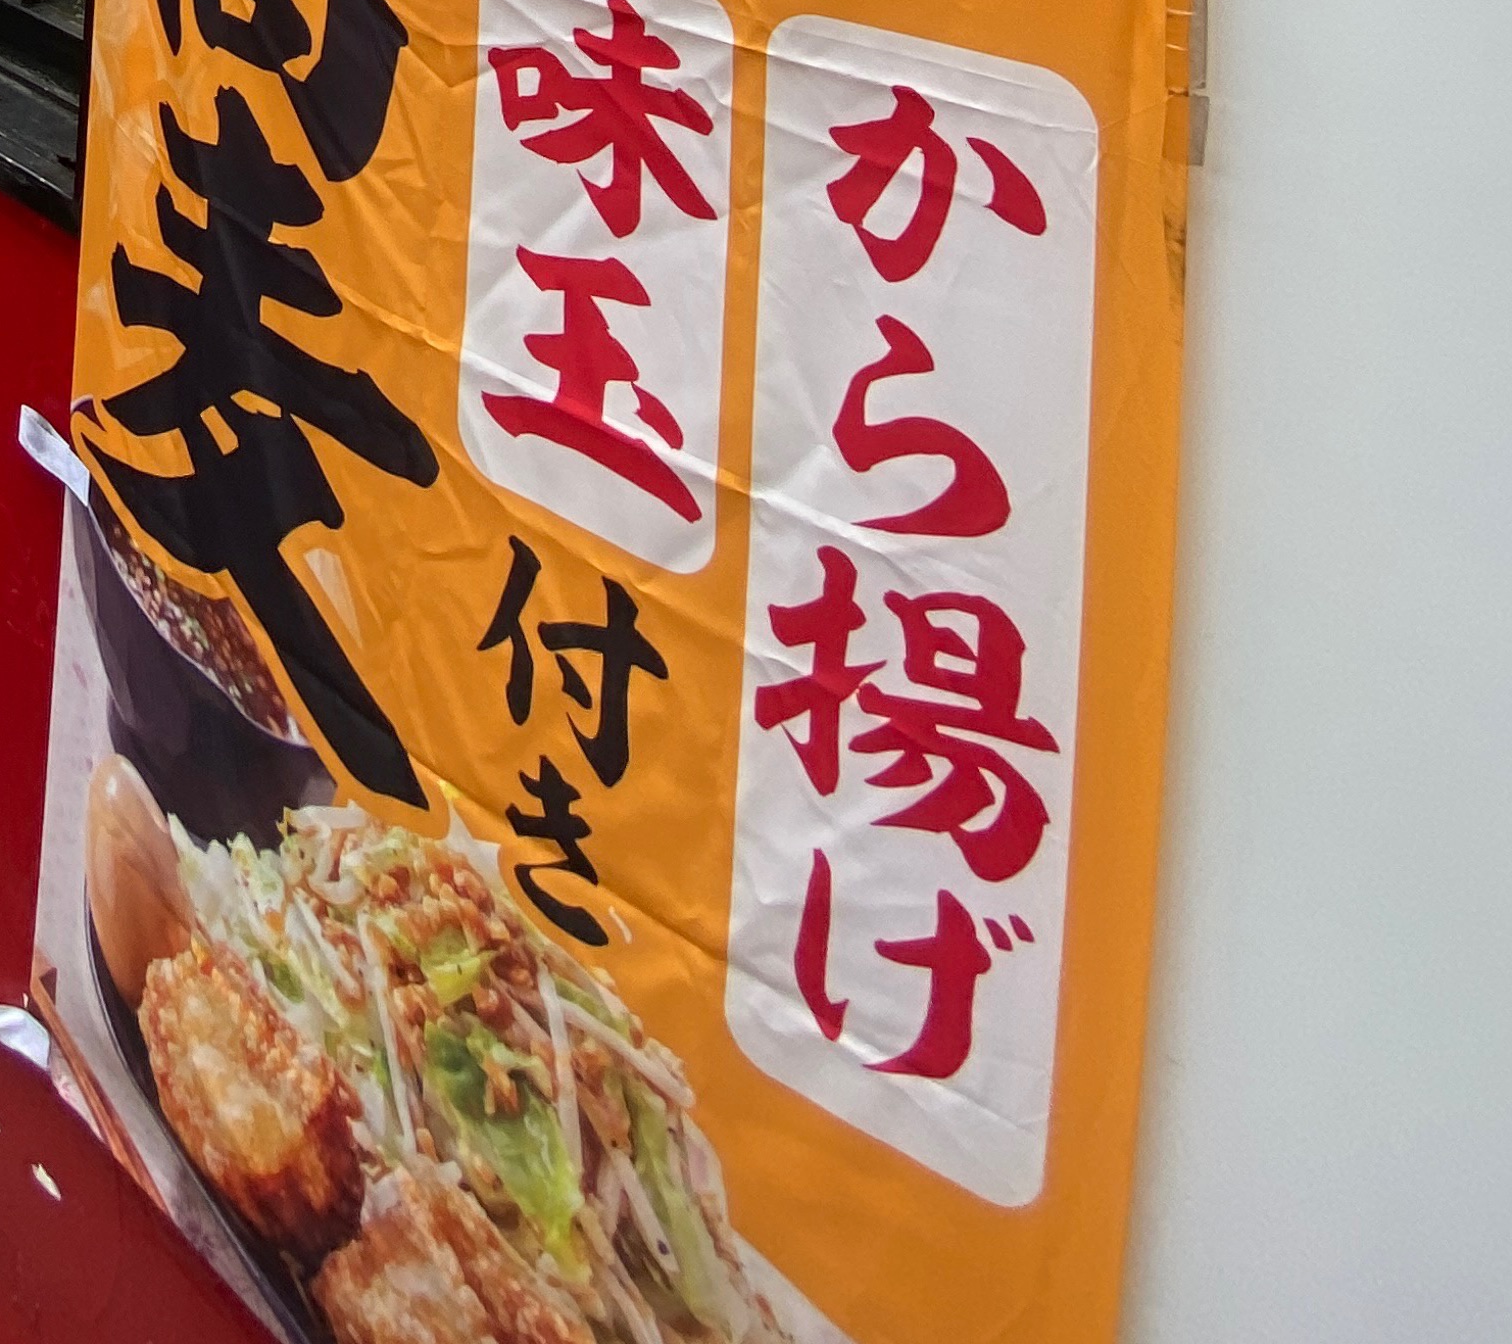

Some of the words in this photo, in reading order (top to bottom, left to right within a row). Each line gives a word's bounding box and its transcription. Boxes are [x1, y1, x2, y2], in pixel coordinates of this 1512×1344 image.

[478, 534, 668, 946] 付き
[753, 83, 1059, 1078] から揚げ
